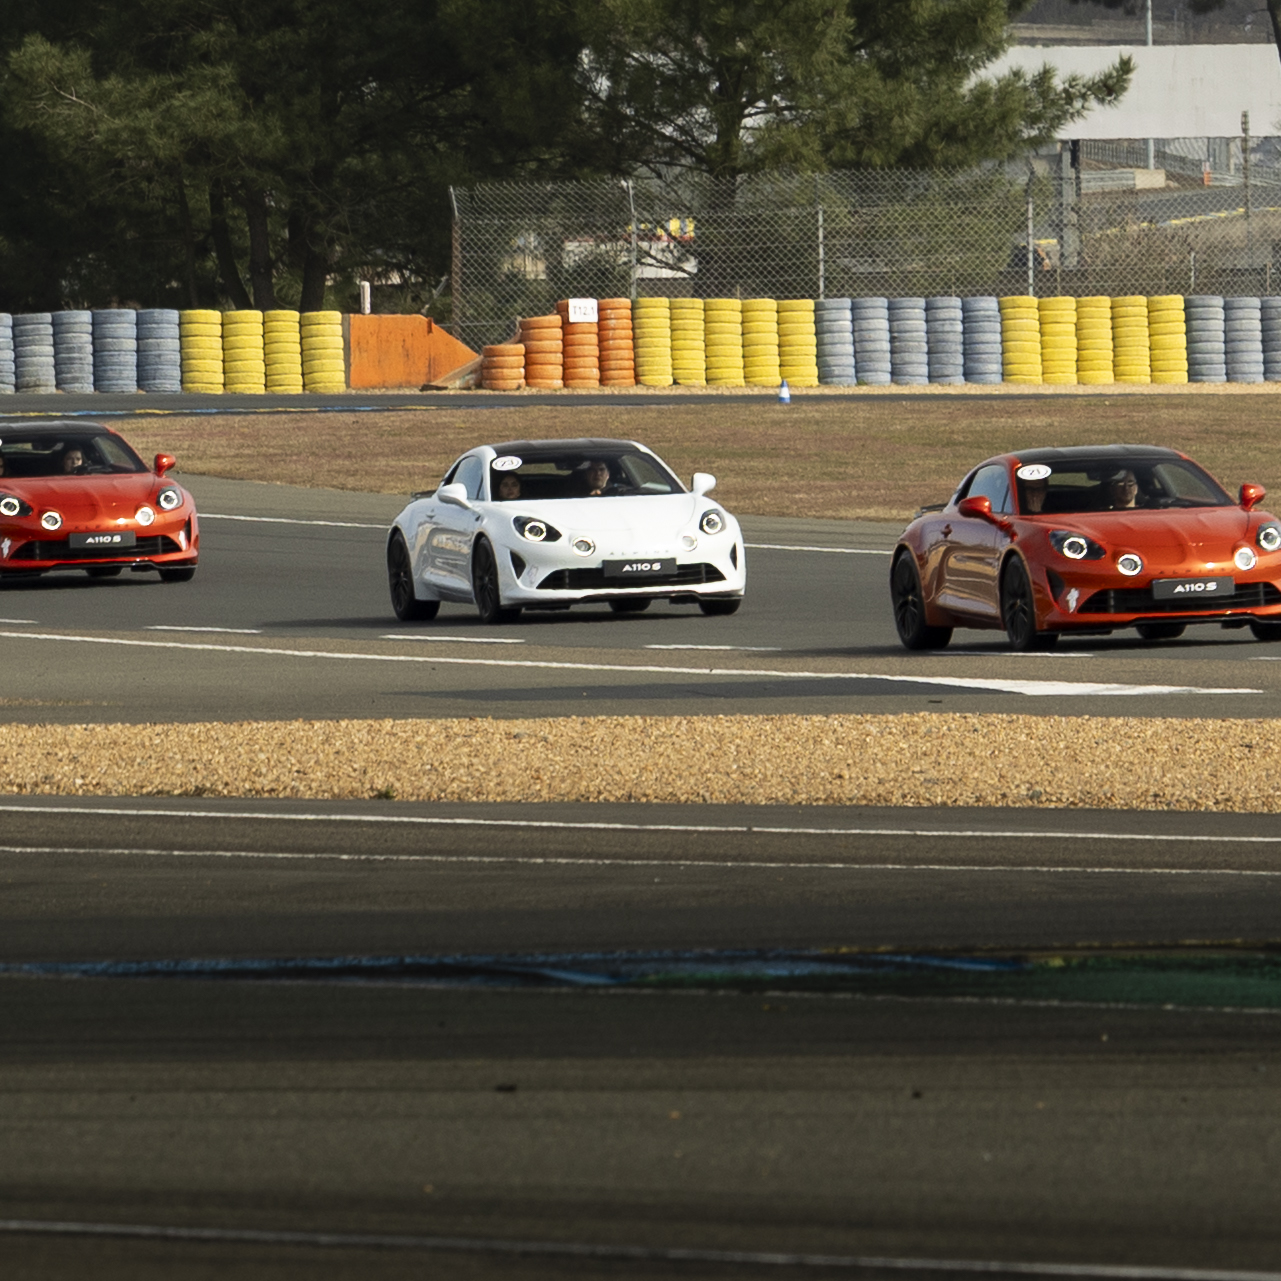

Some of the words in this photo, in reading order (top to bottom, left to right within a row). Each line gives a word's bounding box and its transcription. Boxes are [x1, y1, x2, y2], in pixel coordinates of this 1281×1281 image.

[85, 535, 112, 544] A110
[622, 562, 651, 572] A110
[1173, 582, 1205, 594] A110
[1205, 581, 1218, 591] S
